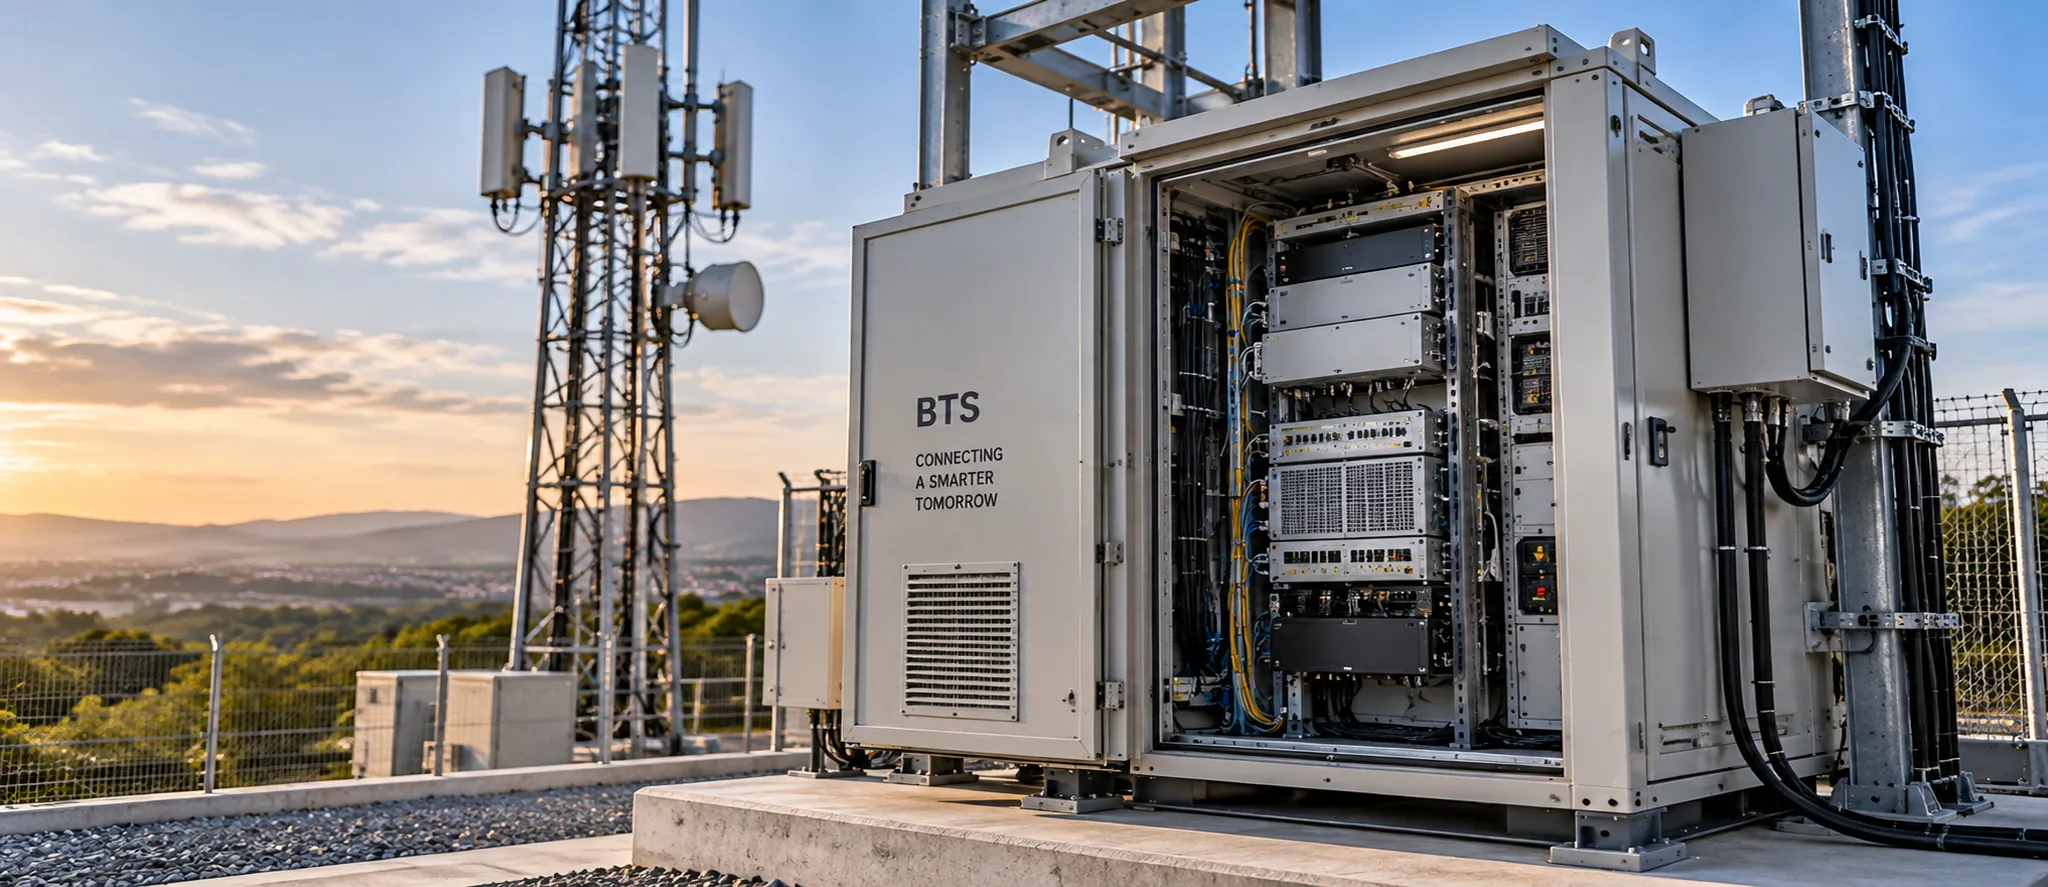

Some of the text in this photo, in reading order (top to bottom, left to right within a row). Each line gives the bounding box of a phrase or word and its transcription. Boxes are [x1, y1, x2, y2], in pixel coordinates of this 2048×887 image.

[917, 391, 980, 427] BTS
[915, 447, 1003, 467] CONNECTING
[915, 470, 994, 489] A SMARTER
[915, 493, 998, 511] TOMORROW
